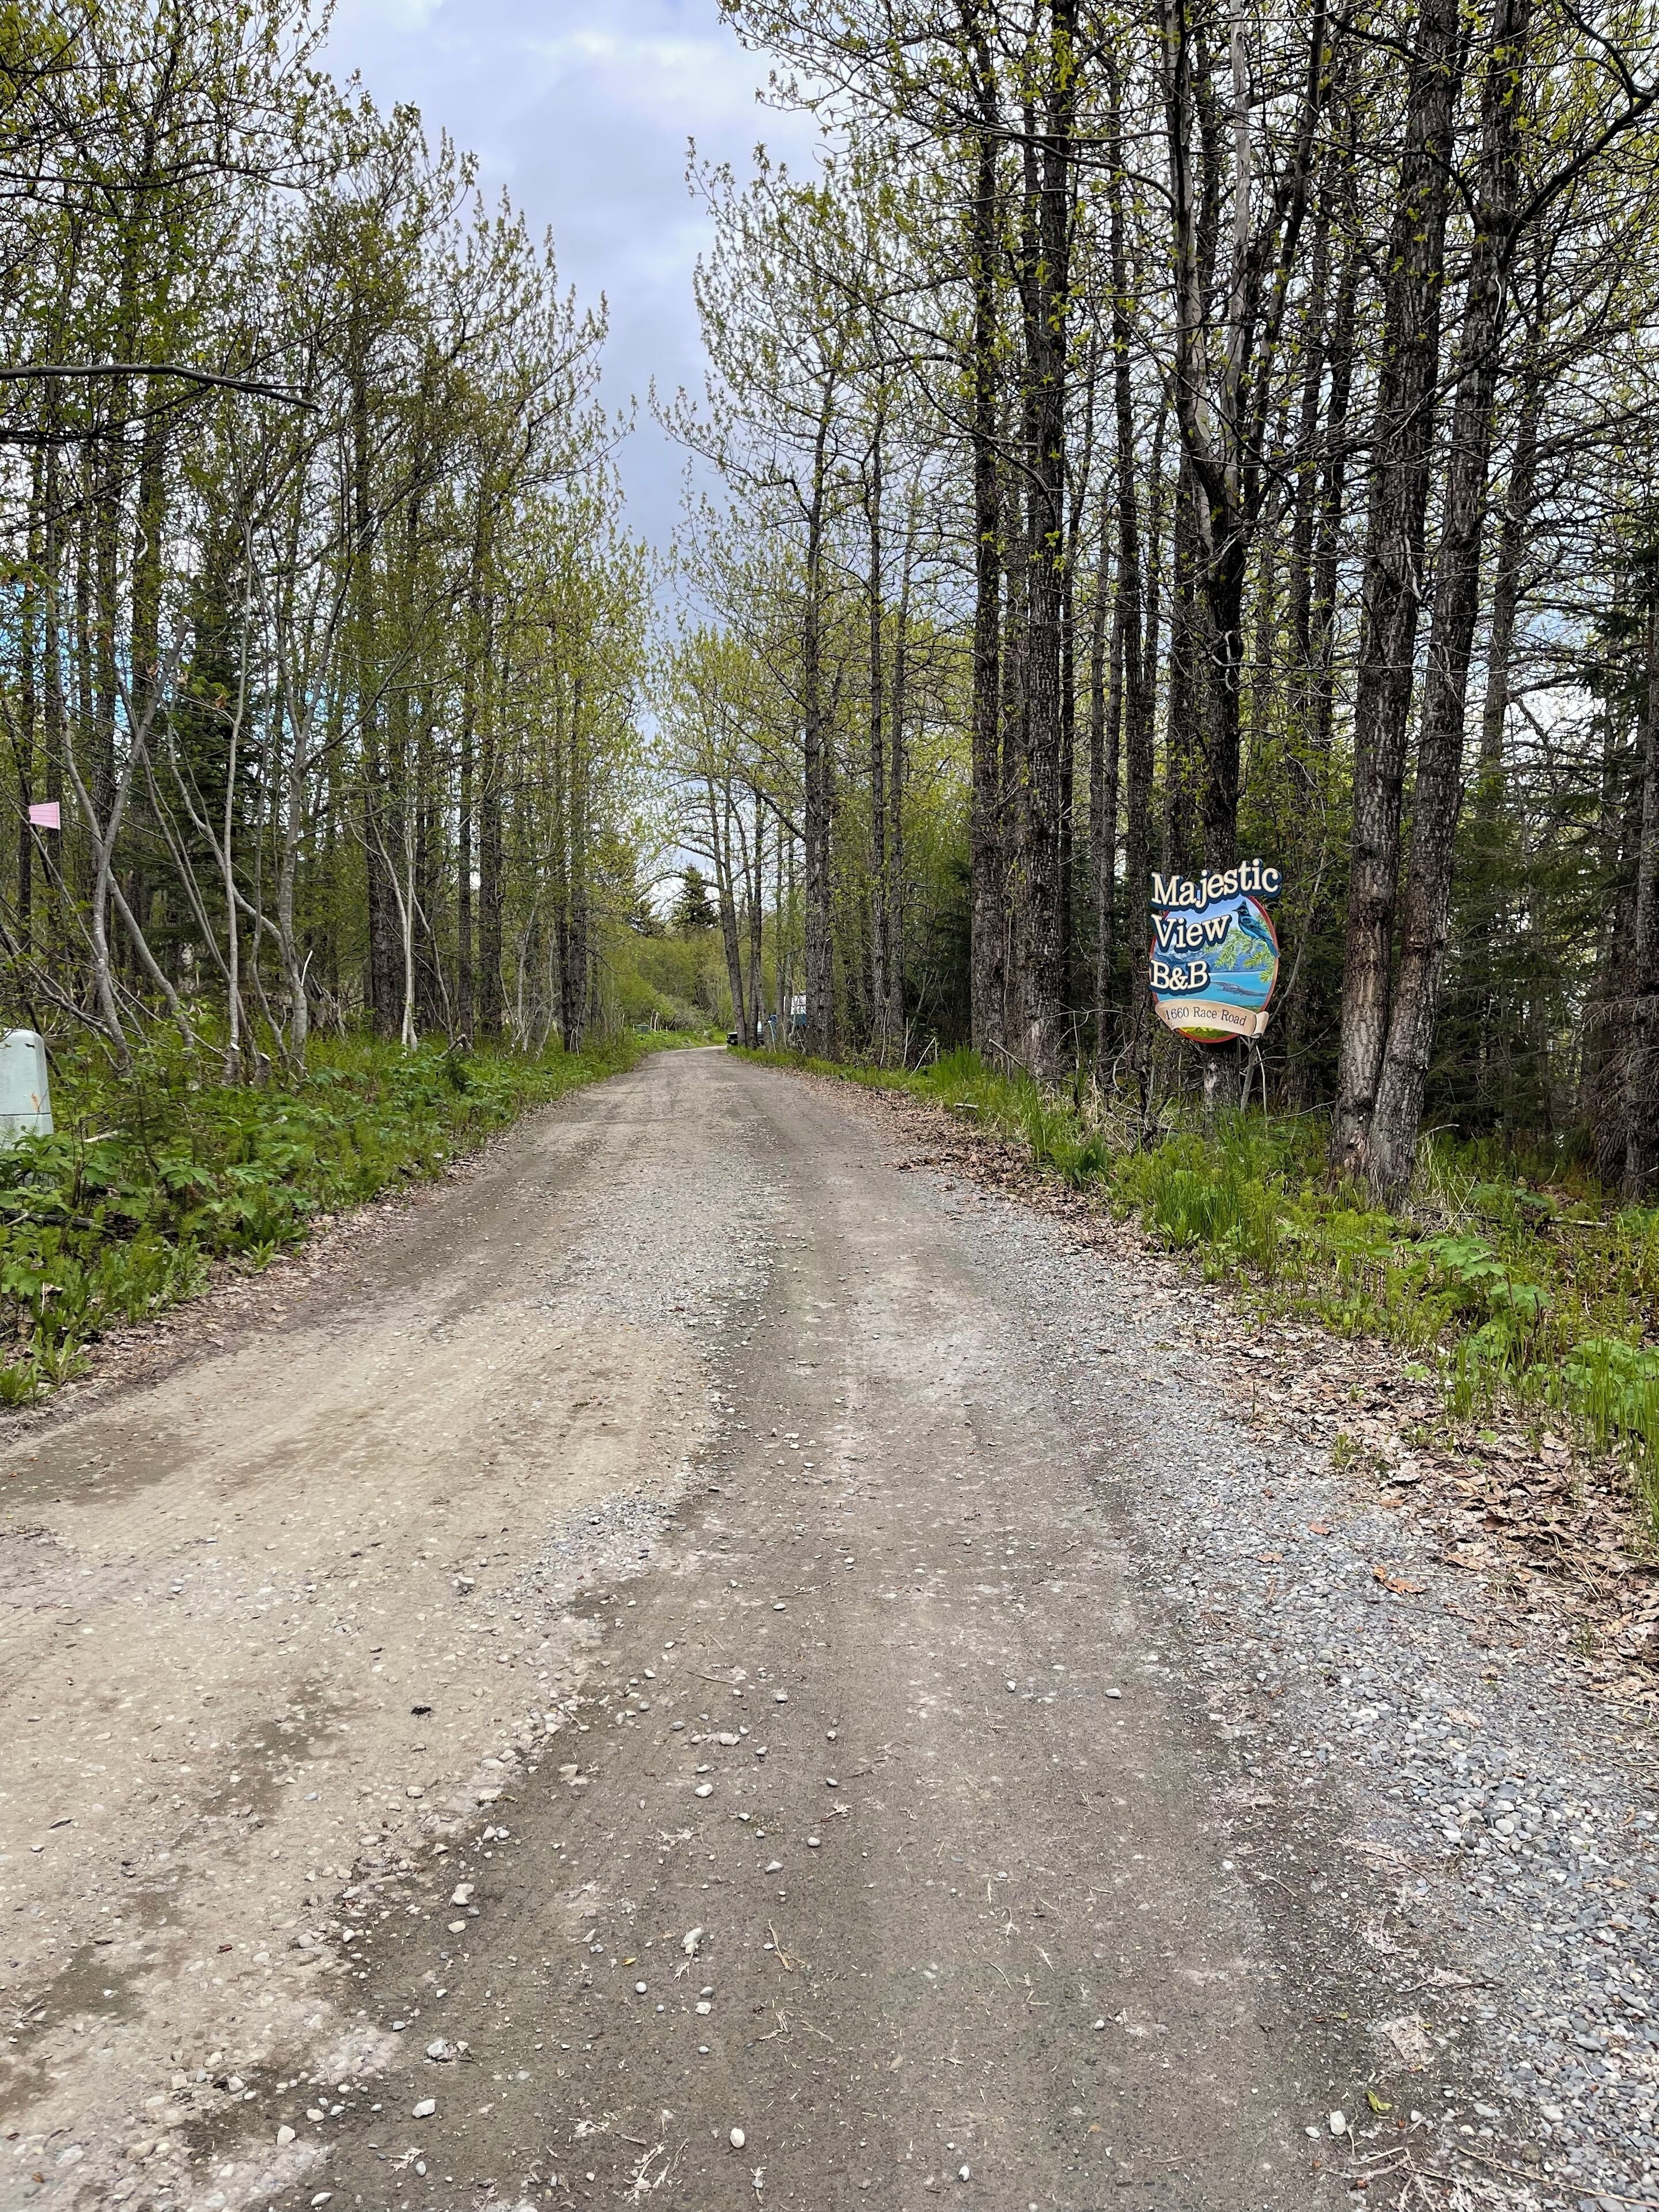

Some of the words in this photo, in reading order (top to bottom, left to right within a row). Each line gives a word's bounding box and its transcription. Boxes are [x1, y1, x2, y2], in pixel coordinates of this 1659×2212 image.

[1152, 858, 1280, 908] Majestic
[1152, 914, 1230, 948] View
[1150, 960, 1208, 990] B&B
[1165, 1007, 1190, 1020] 1660
[1193, 1006, 1217, 1019] Race
[1221, 1009, 1247, 1027] Road
